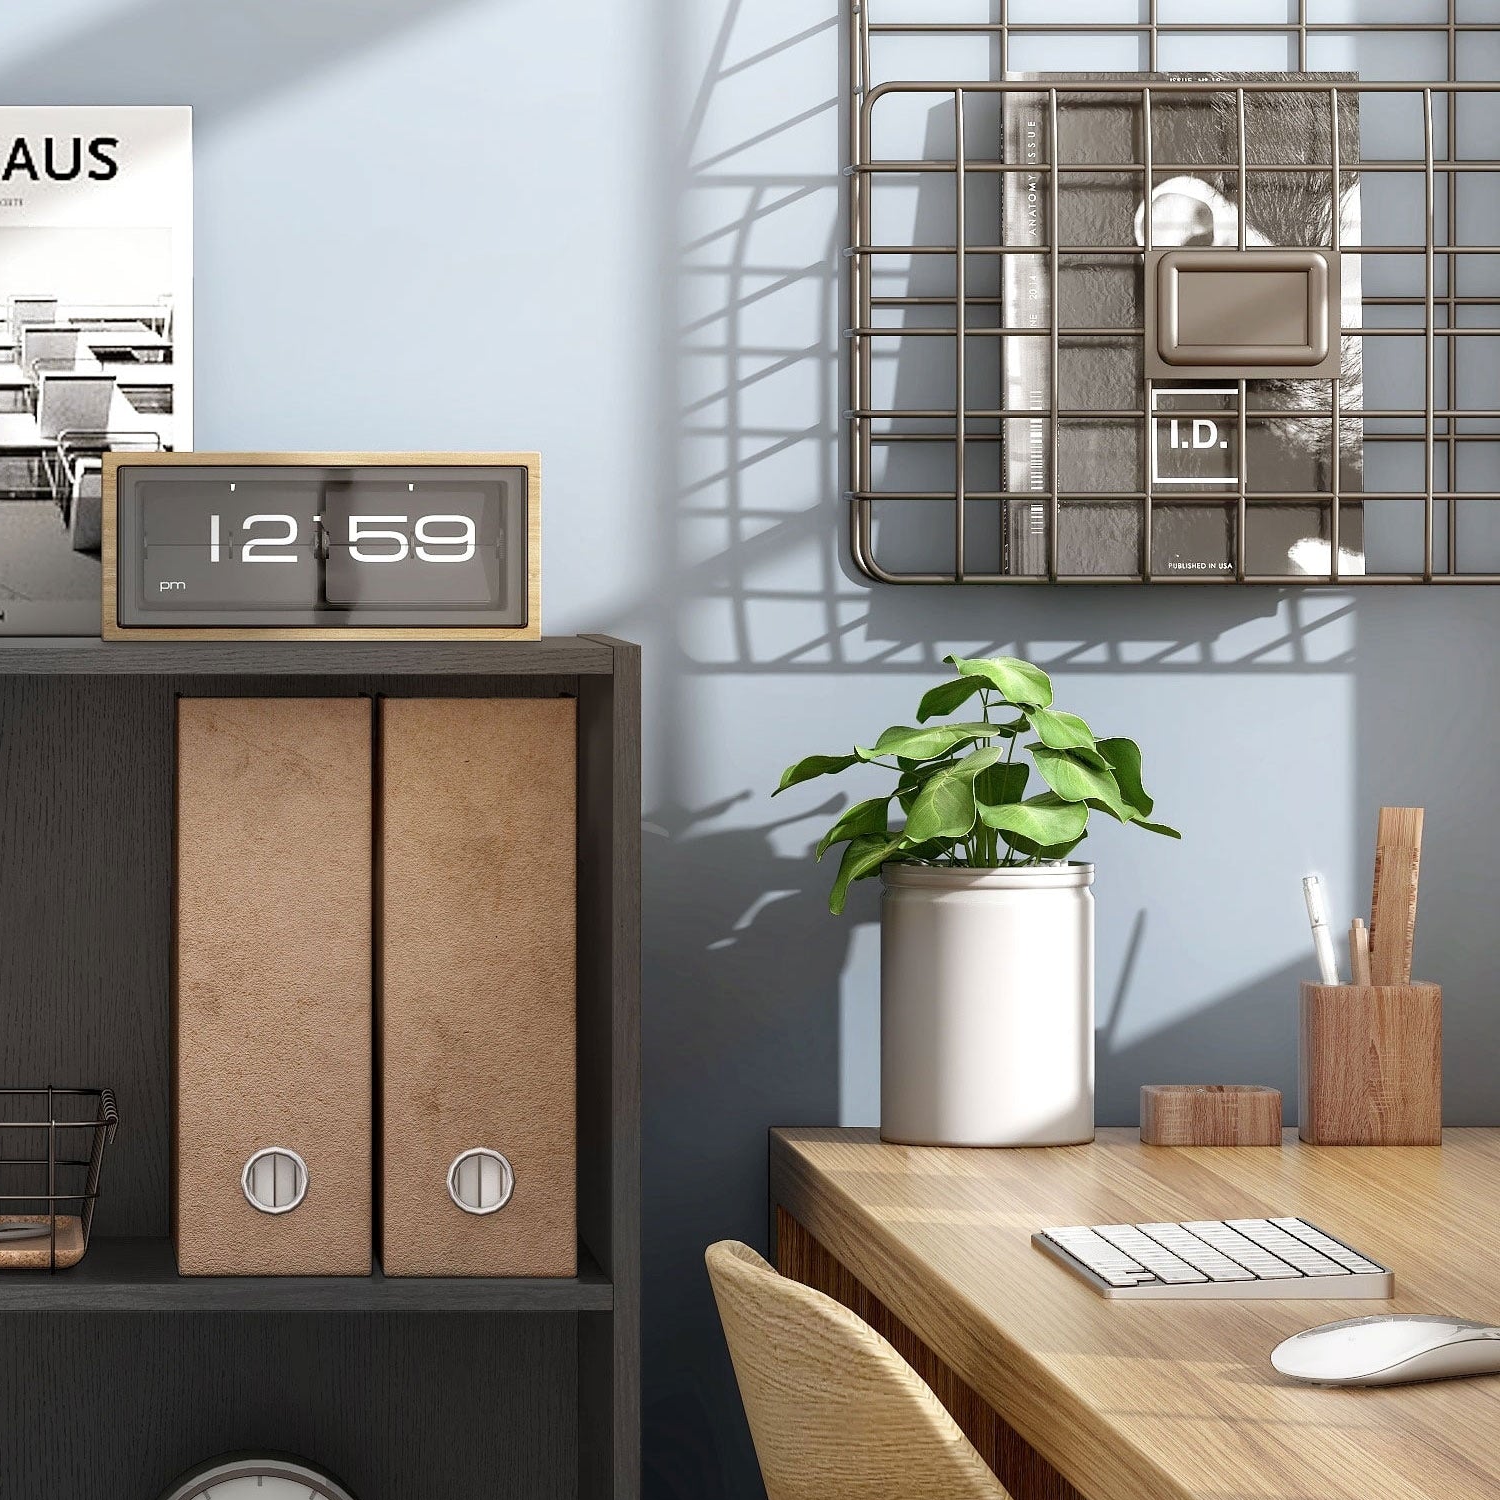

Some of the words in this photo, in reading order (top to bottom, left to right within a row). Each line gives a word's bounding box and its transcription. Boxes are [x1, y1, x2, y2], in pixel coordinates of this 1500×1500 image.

[1028, 120, 1036, 164] ISSUE
[1028, 174, 1037, 236] ANATOMY
[1170, 419, 1228, 449] I.D.
[1168, 562, 1207, 570] PUBLISHED
[1218, 562, 1233, 570] USA
[159, 581, 186, 592] pm
